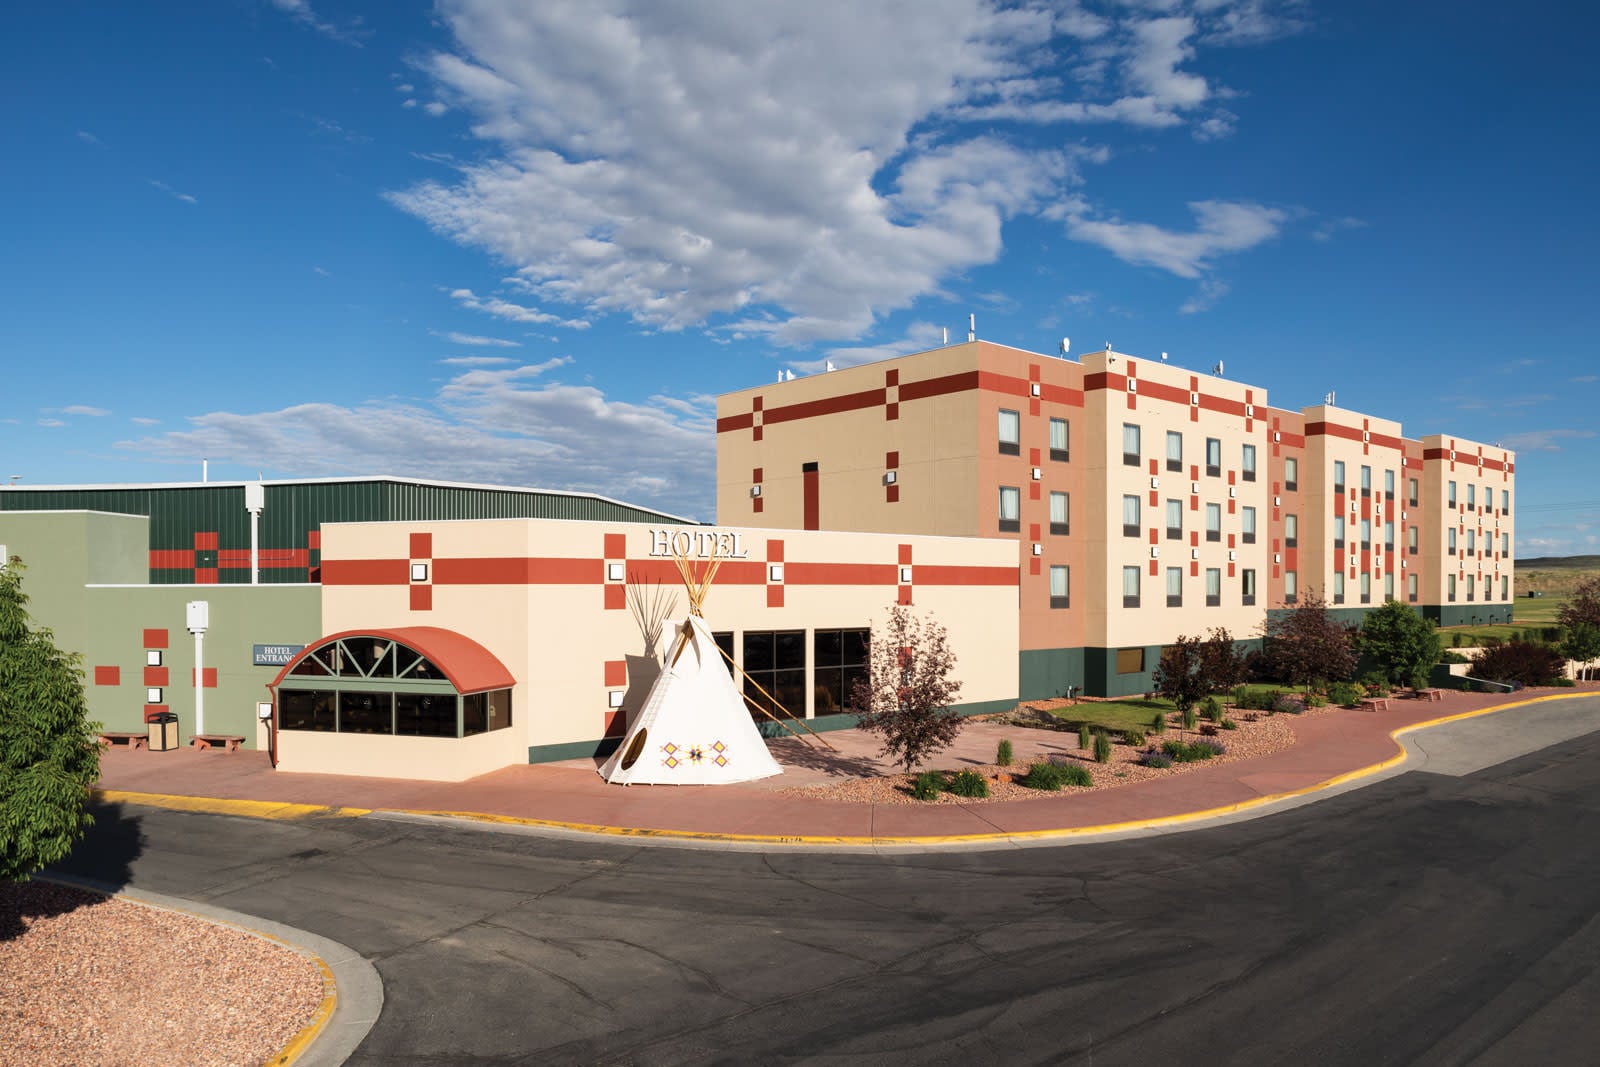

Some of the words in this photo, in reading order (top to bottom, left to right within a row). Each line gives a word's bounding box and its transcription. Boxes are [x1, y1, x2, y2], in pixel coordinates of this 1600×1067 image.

[649, 529, 748, 558] HOTEL
[264, 646, 292, 655] HOTEL
[256, 654, 296, 662] ENTRANC
